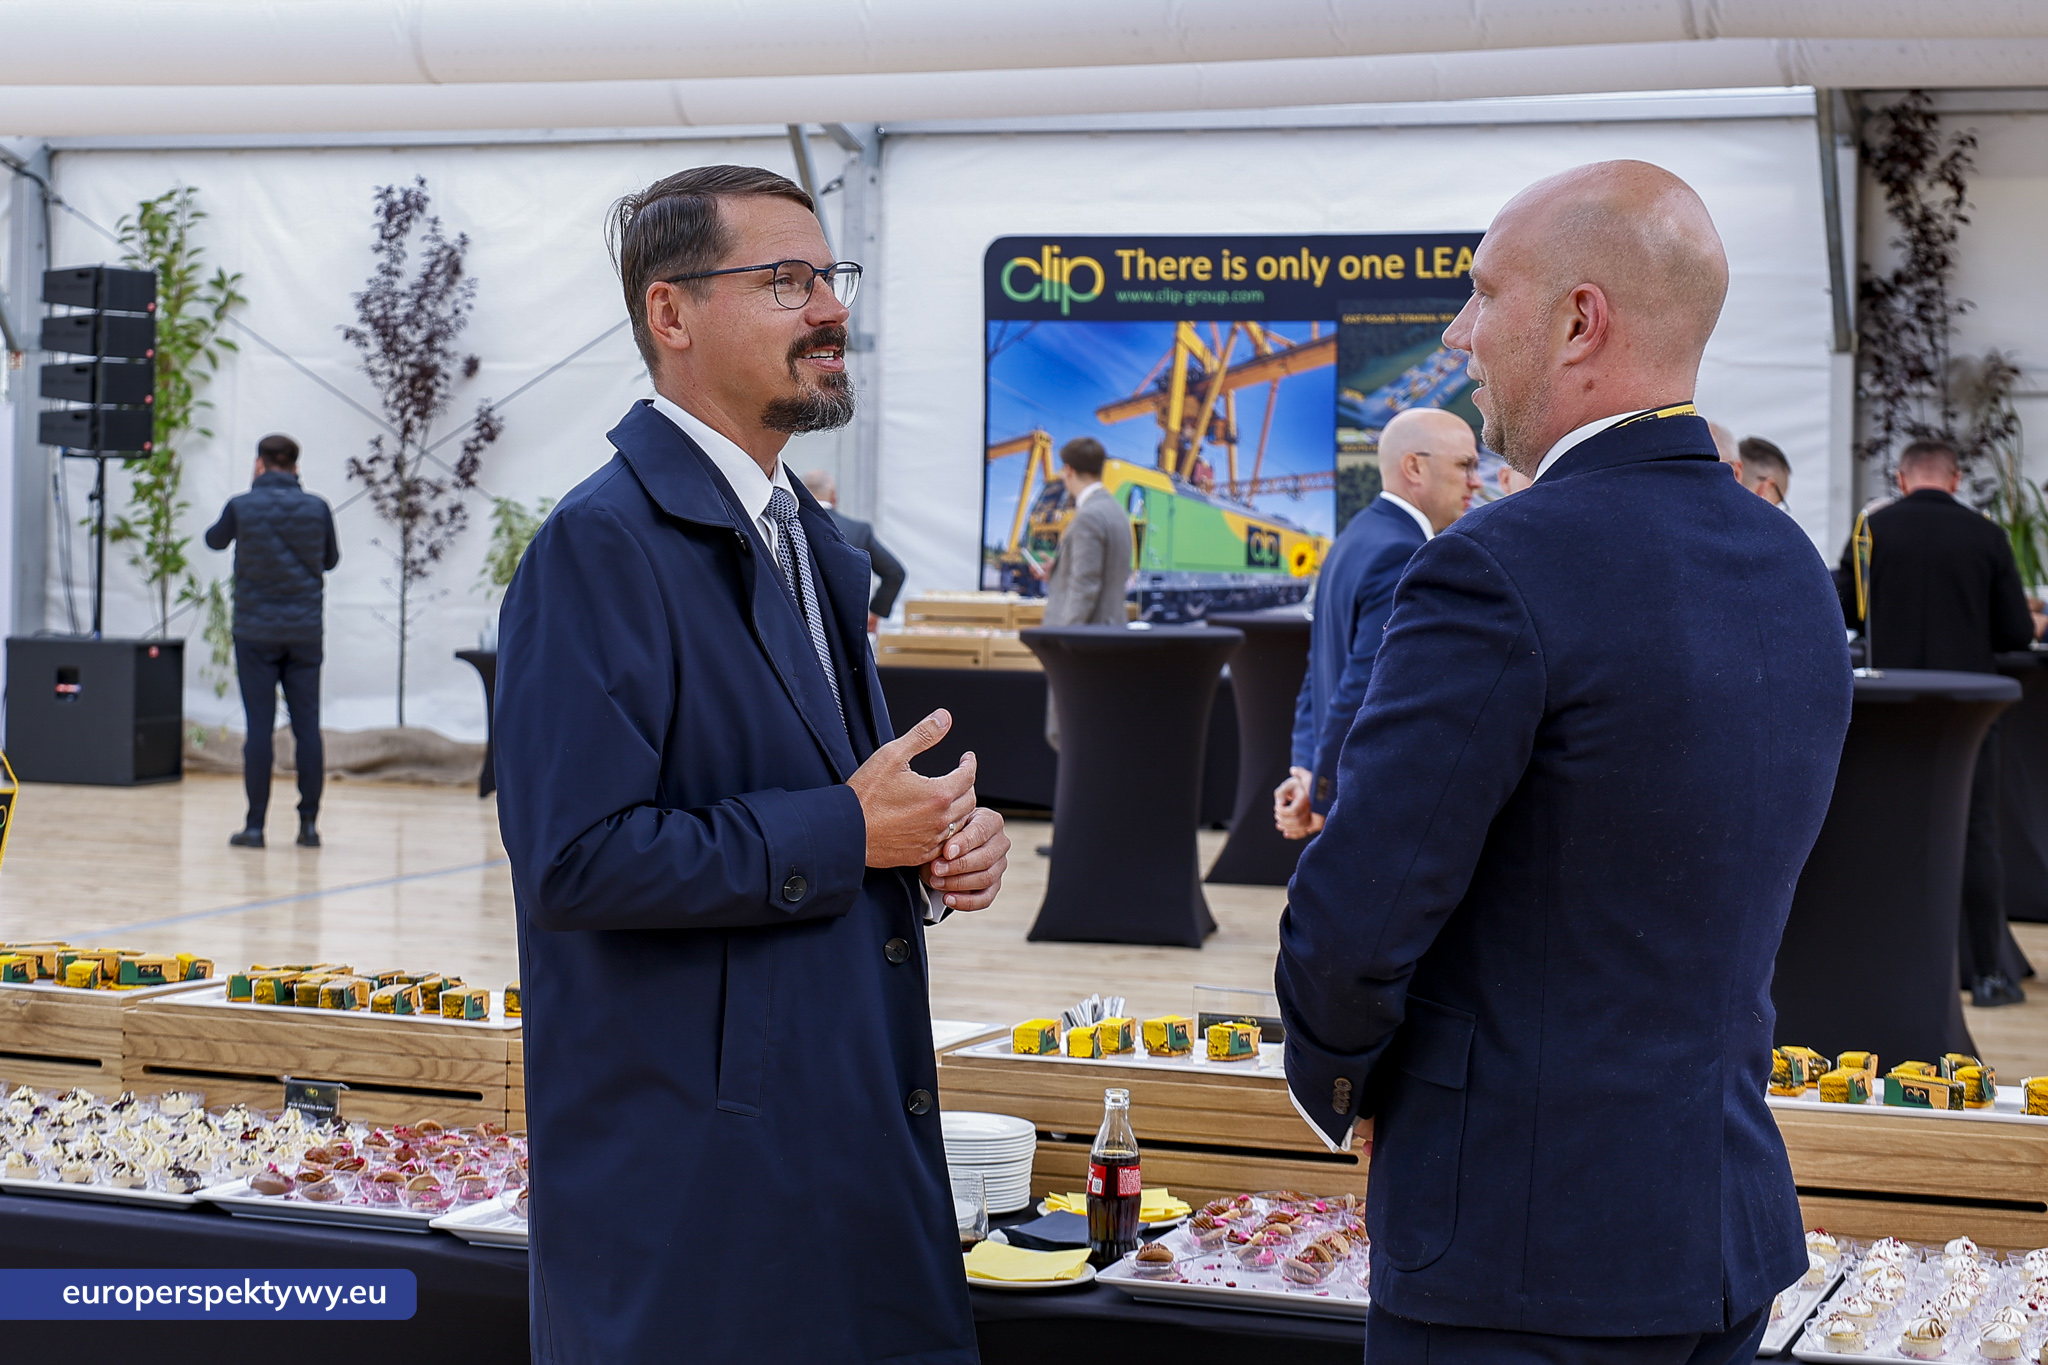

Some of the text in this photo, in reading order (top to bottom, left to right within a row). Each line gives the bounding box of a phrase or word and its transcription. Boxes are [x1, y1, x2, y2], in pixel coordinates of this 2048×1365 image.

[1001, 245, 1105, 316] clip
[1115, 247, 1213, 281] There
[1222, 248, 1249, 281] is
[1256, 247, 1331, 288] only
[1338, 254, 1405, 280] one
[1115, 287, 1265, 306] www.clip-group.com
